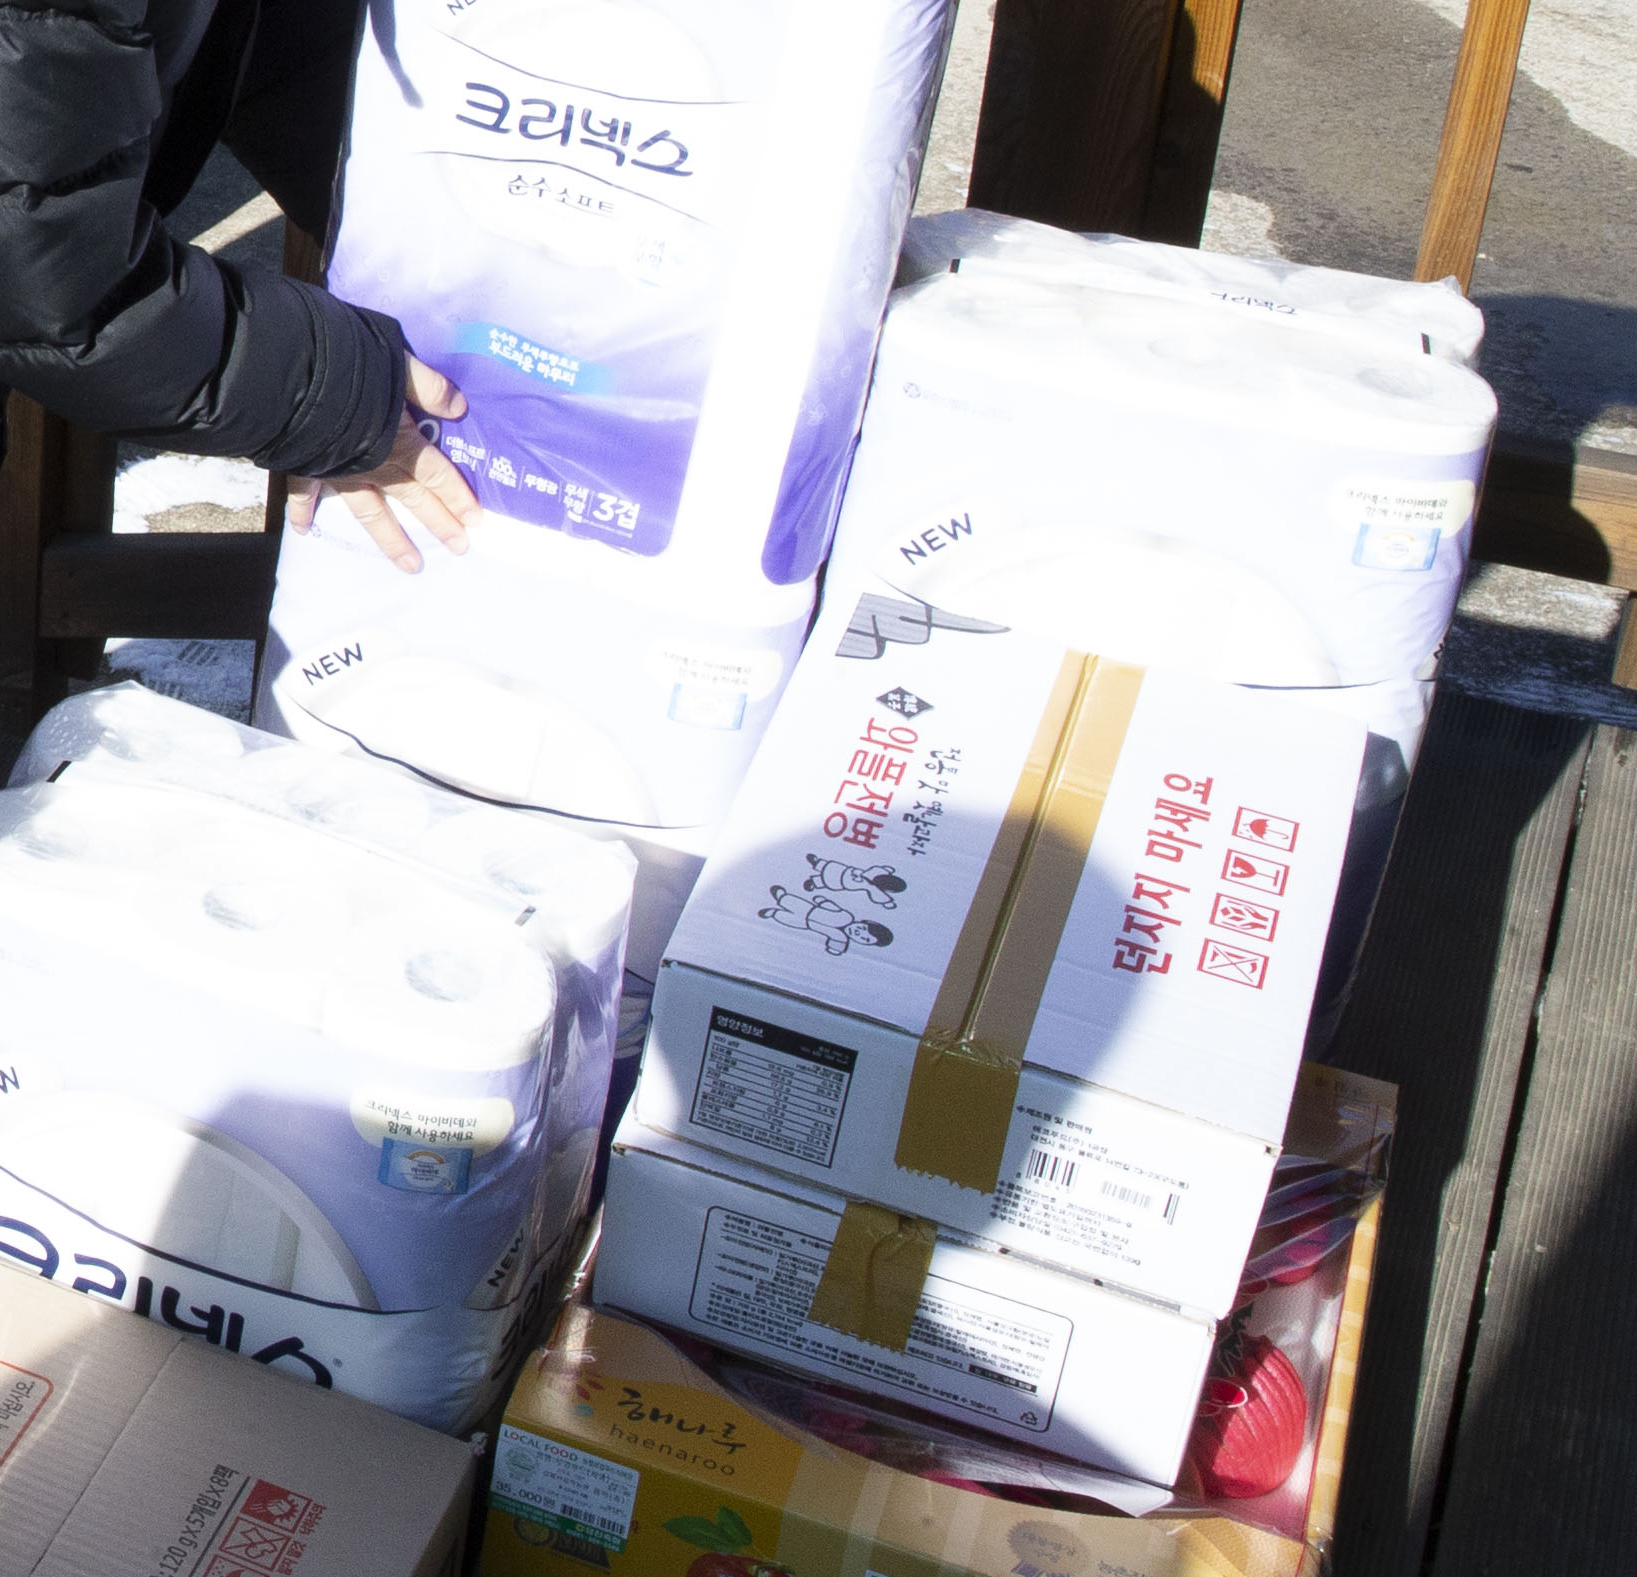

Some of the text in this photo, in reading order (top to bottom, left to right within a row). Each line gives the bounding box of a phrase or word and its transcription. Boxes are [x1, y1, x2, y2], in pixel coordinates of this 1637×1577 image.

[456, 82, 693, 177] 크리넥스
[593, 491, 640, 530] 3겹
[899, 512, 974, 566] NEW
[302, 642, 364, 686] NEW
[824, 717, 918, 850] 와플전병
[1112, 771, 1214, 975] 던지지 마세요
[387, 1120, 474, 1143] 함께 사용하세요
[417, 1113, 477, 1128] 마이비데와
[487, 1227, 524, 1287] NEW
[503, 1429, 579, 1462] LOCAL FOOD
[612, 1386, 753, 1457] 해나루
[607, 1424, 739, 1476] haenaroo
